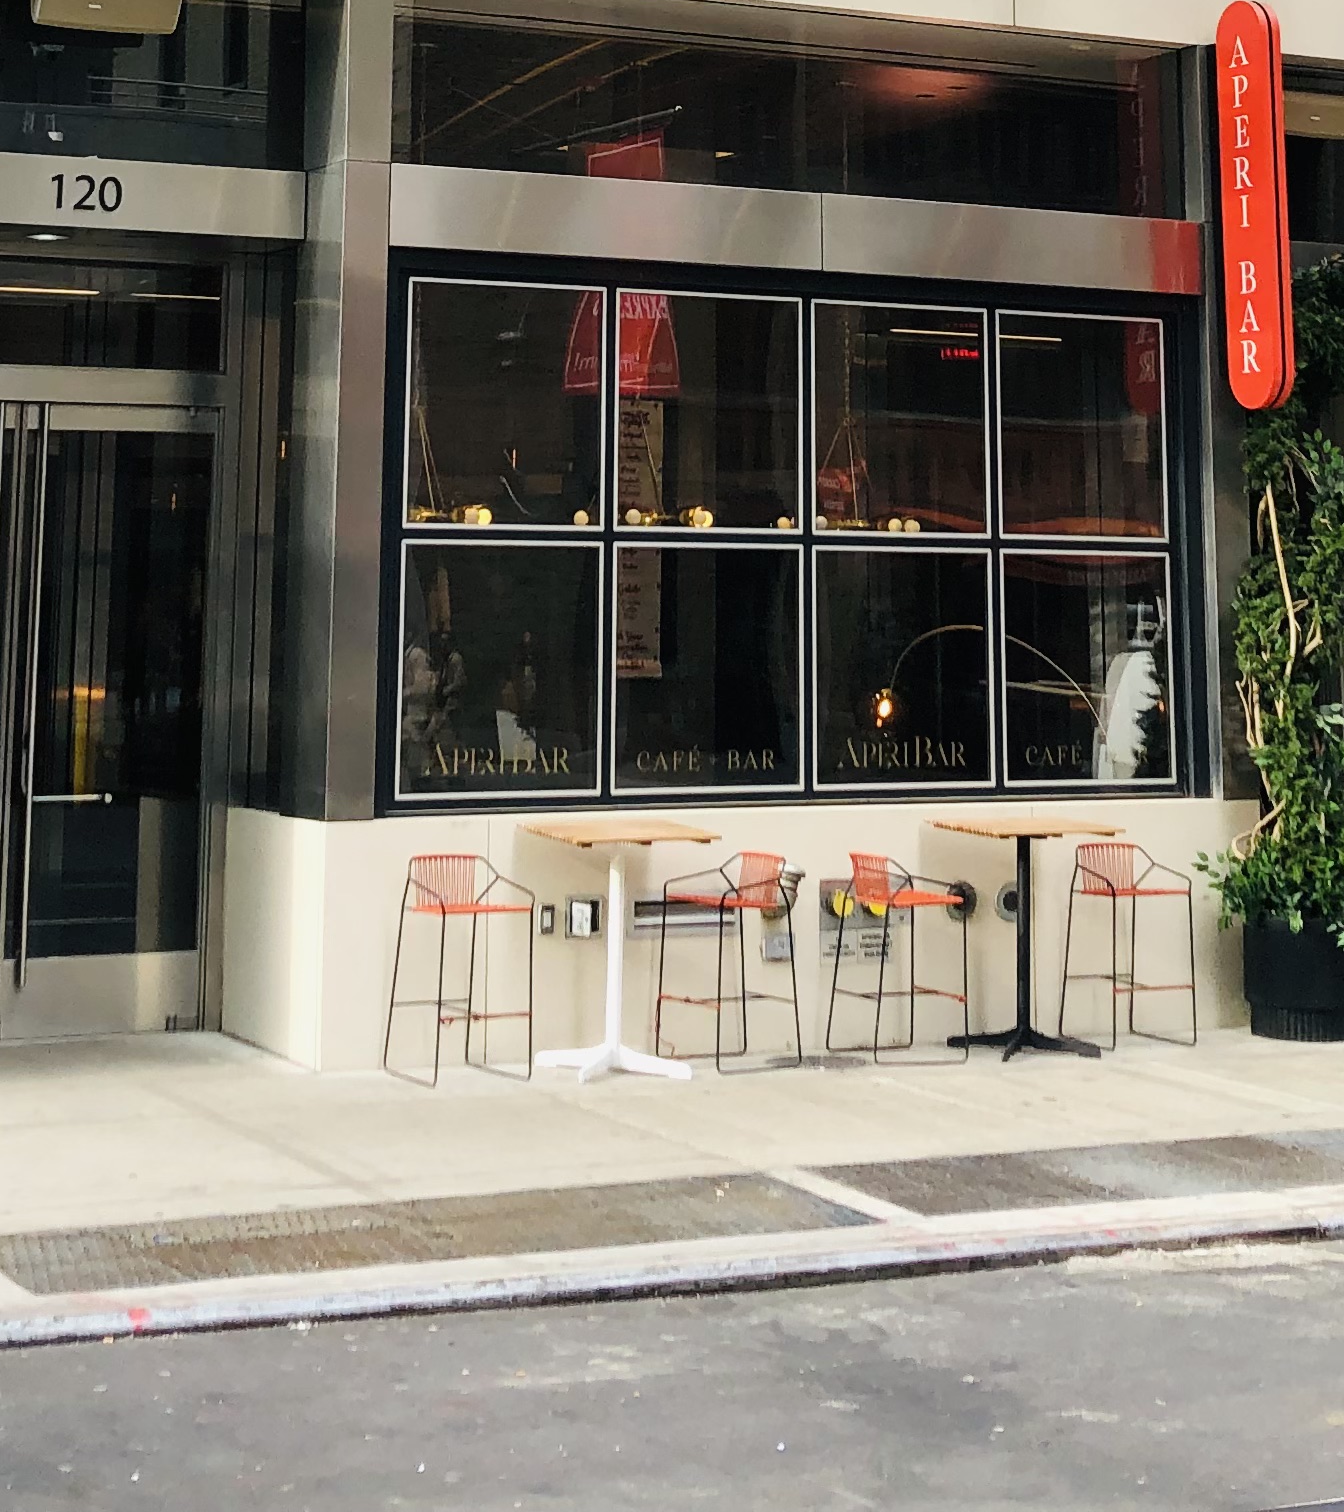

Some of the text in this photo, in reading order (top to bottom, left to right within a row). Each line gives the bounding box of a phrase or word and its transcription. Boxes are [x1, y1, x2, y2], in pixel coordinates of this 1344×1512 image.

[51, 173, 123, 212] 120
[1228, 35, 1261, 374] APERI BAR
[636, 744, 776, 773] CAFÉ BAR
